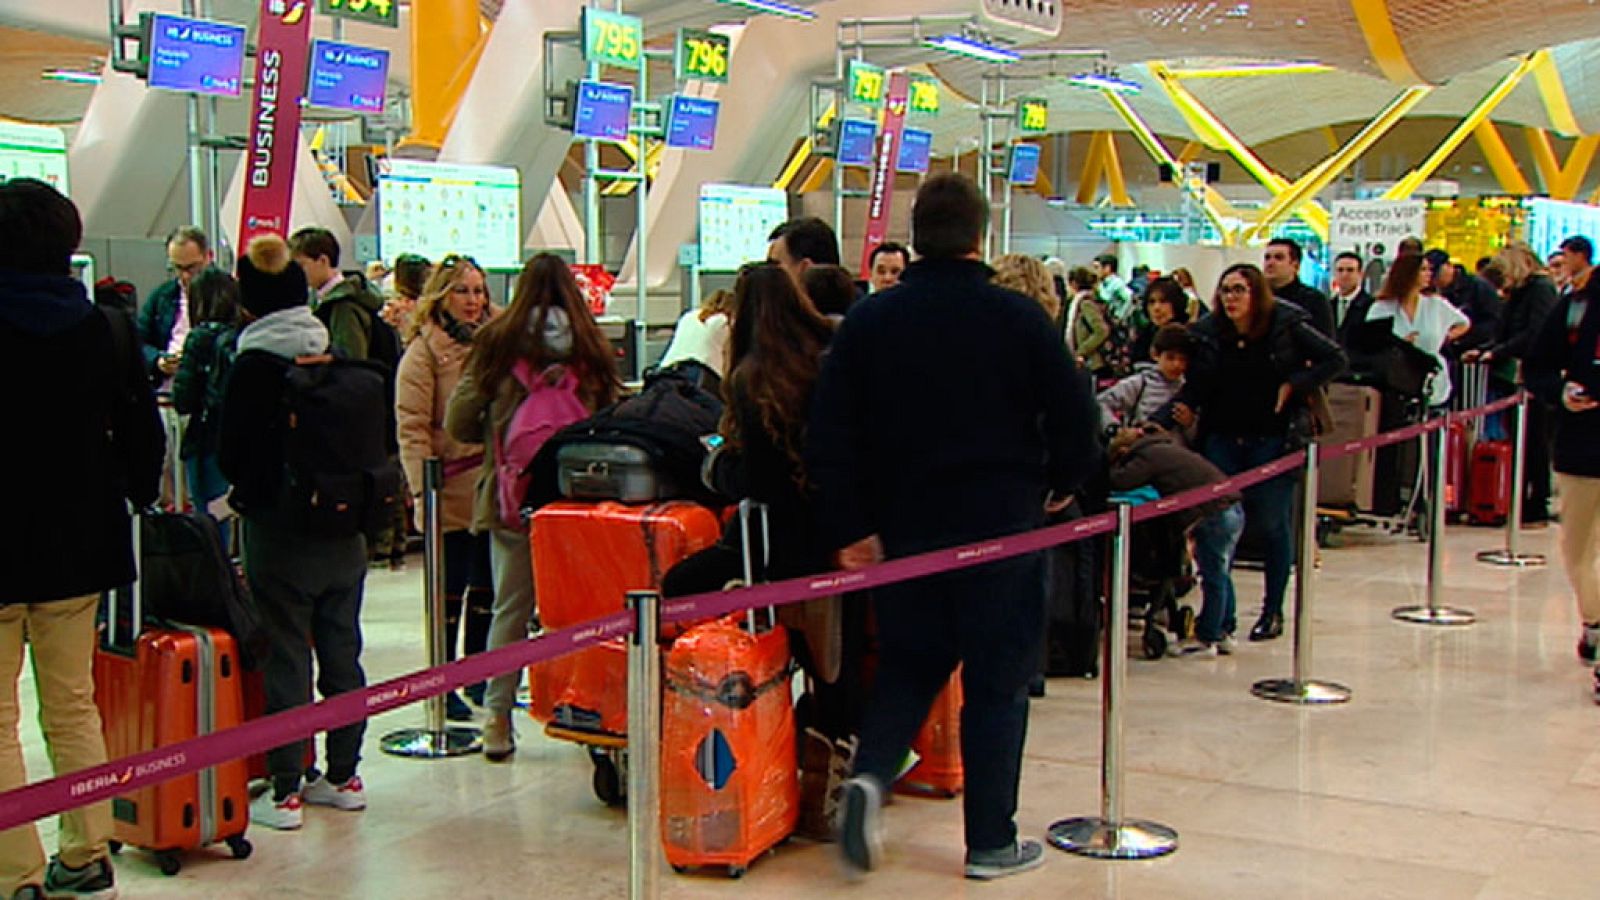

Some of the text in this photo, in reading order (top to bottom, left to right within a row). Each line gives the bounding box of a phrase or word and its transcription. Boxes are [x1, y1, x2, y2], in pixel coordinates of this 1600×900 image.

[594, 18, 639, 60] 795
[685, 38, 727, 76] 796
[252, 50, 282, 187] BUSINESS
[1338, 205, 1419, 219] Acceso VIP
[1340, 222, 1412, 236] Fast Track
[70, 752, 187, 797] IBERIA BUSINESS
